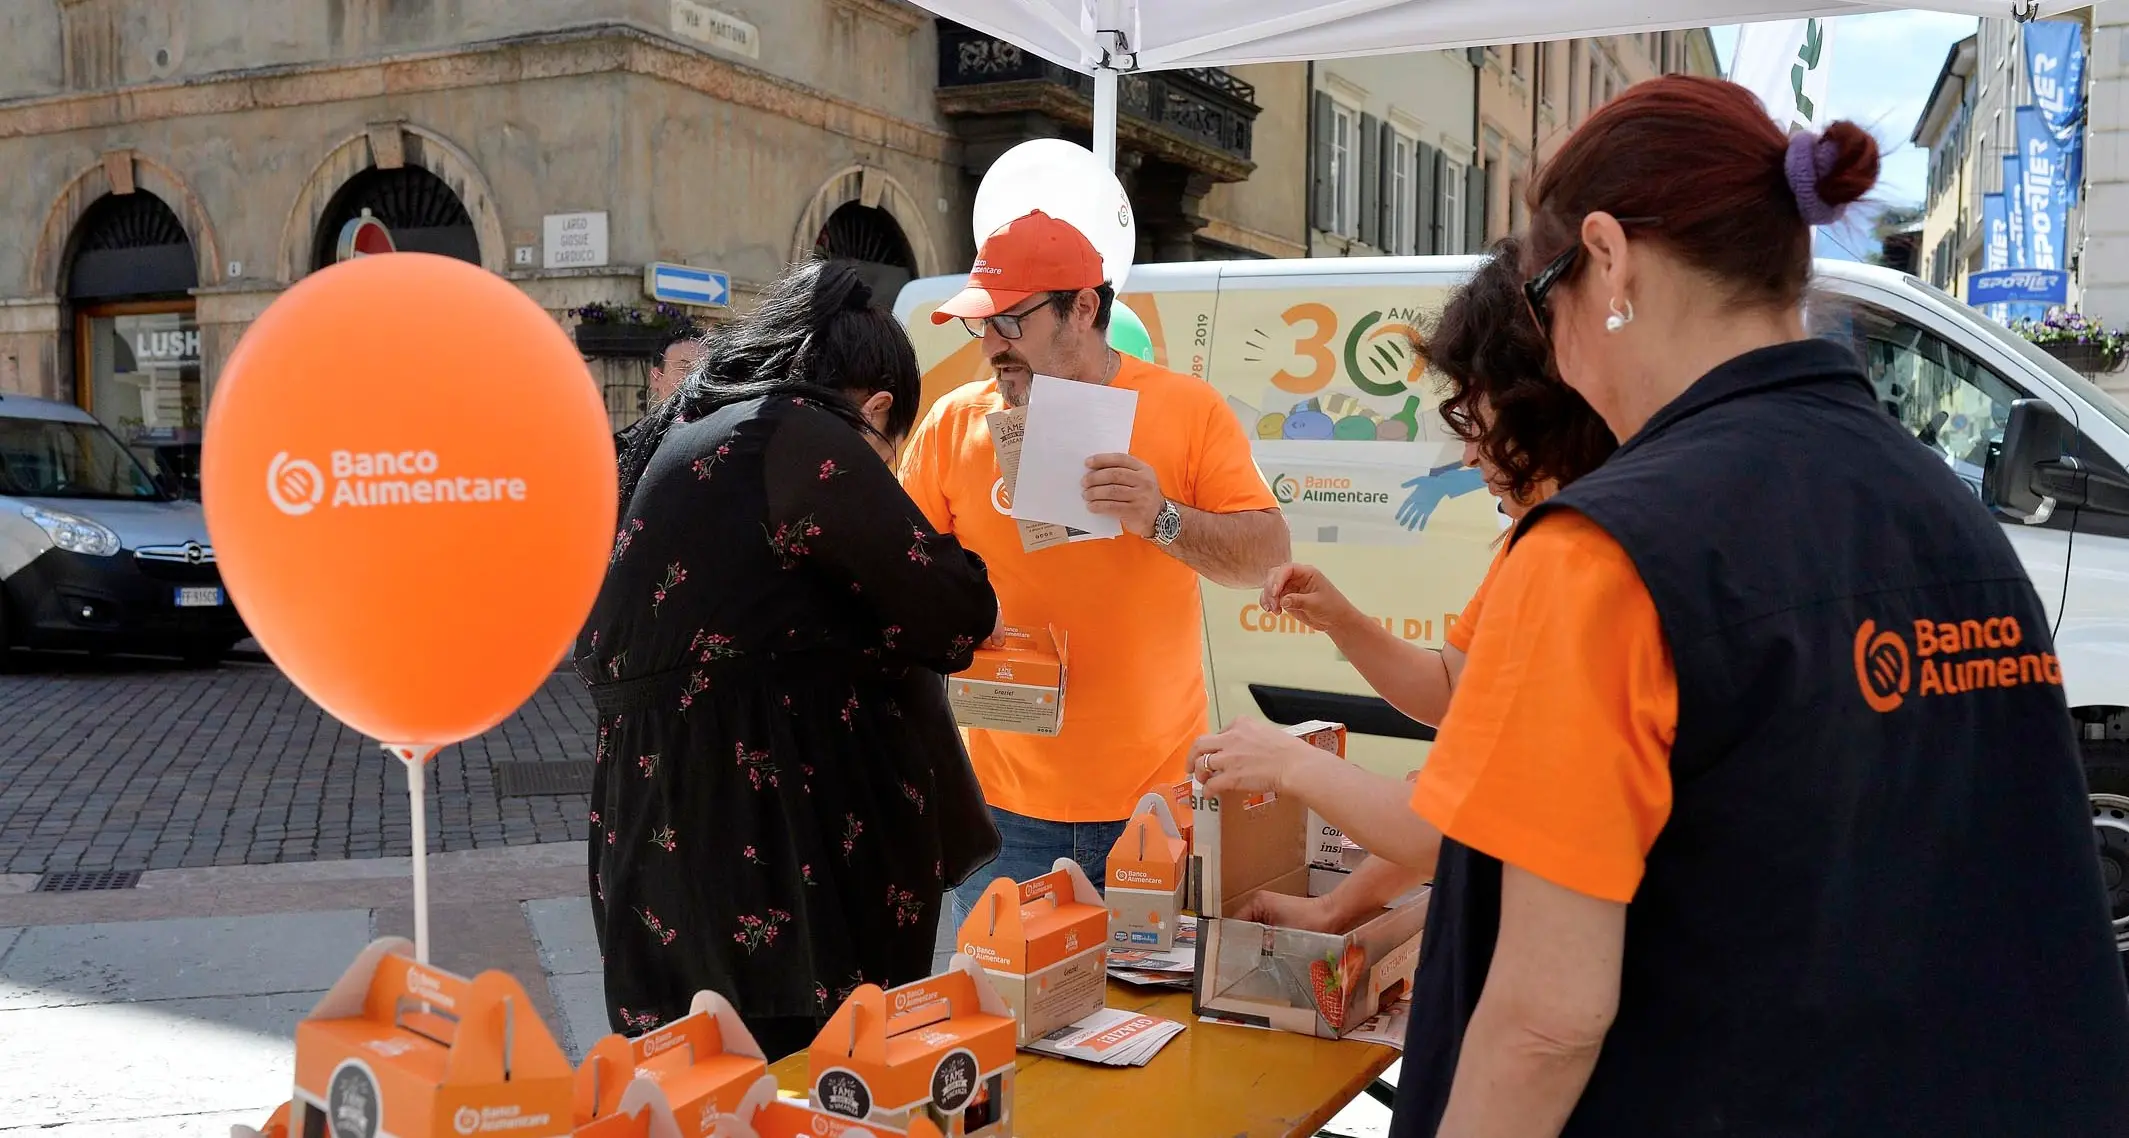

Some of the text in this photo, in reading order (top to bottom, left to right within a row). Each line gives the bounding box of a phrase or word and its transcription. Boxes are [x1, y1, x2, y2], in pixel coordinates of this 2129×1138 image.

[562, 218, 588, 231] LARGO
[520, 249, 527, 261] 2
[554, 249, 595, 263] CARDUCCI
[1977, 271, 2059, 292] SPORTLER
[1194, 313, 1209, 347] 2019
[137, 331, 200, 357] LUSH
[1001, 422, 1024, 435] FAME
[330, 449, 439, 478] Banco
[1304, 476, 1351, 489] Banco
[331, 475, 528, 508] Alimentare
[1303, 489, 1389, 503] Alimentare
[1403, 618, 1432, 641] DI
[1913, 616, 2023, 657] Banco
[1127, 876, 1162, 884] Alimentare
[1128, 870, 1147, 878] Banco
[976, 946, 995, 955] Banco
[976, 951, 1011, 965] Alimentare
[1097, 1018, 1153, 1044] GRAZIE!
[944, 1069, 965, 1084] FAME
[831, 1086, 856, 1098] FAME
